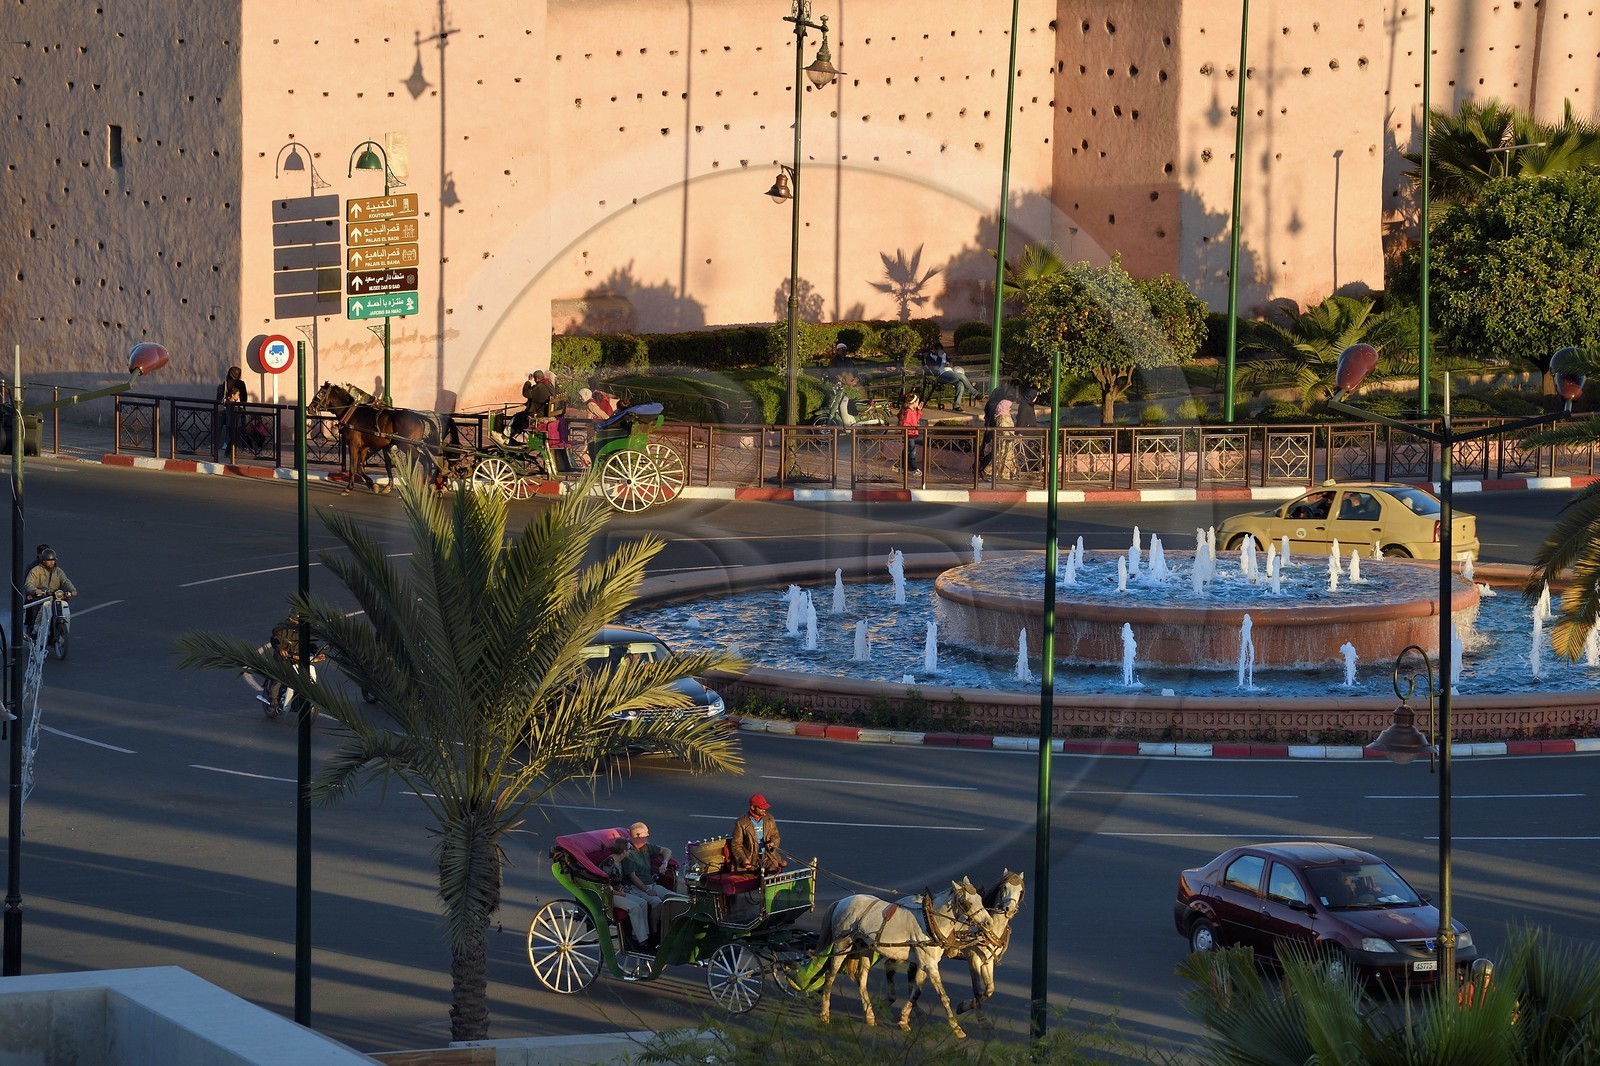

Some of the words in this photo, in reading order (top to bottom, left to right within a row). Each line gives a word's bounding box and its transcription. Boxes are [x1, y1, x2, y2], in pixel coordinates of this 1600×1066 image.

[366, 198, 398, 212] الكتبية
[363, 224, 387, 237] البديع
[387, 223, 400, 235] قصر
[364, 248, 387, 261] الباهية
[387, 248, 400, 260] قصر
